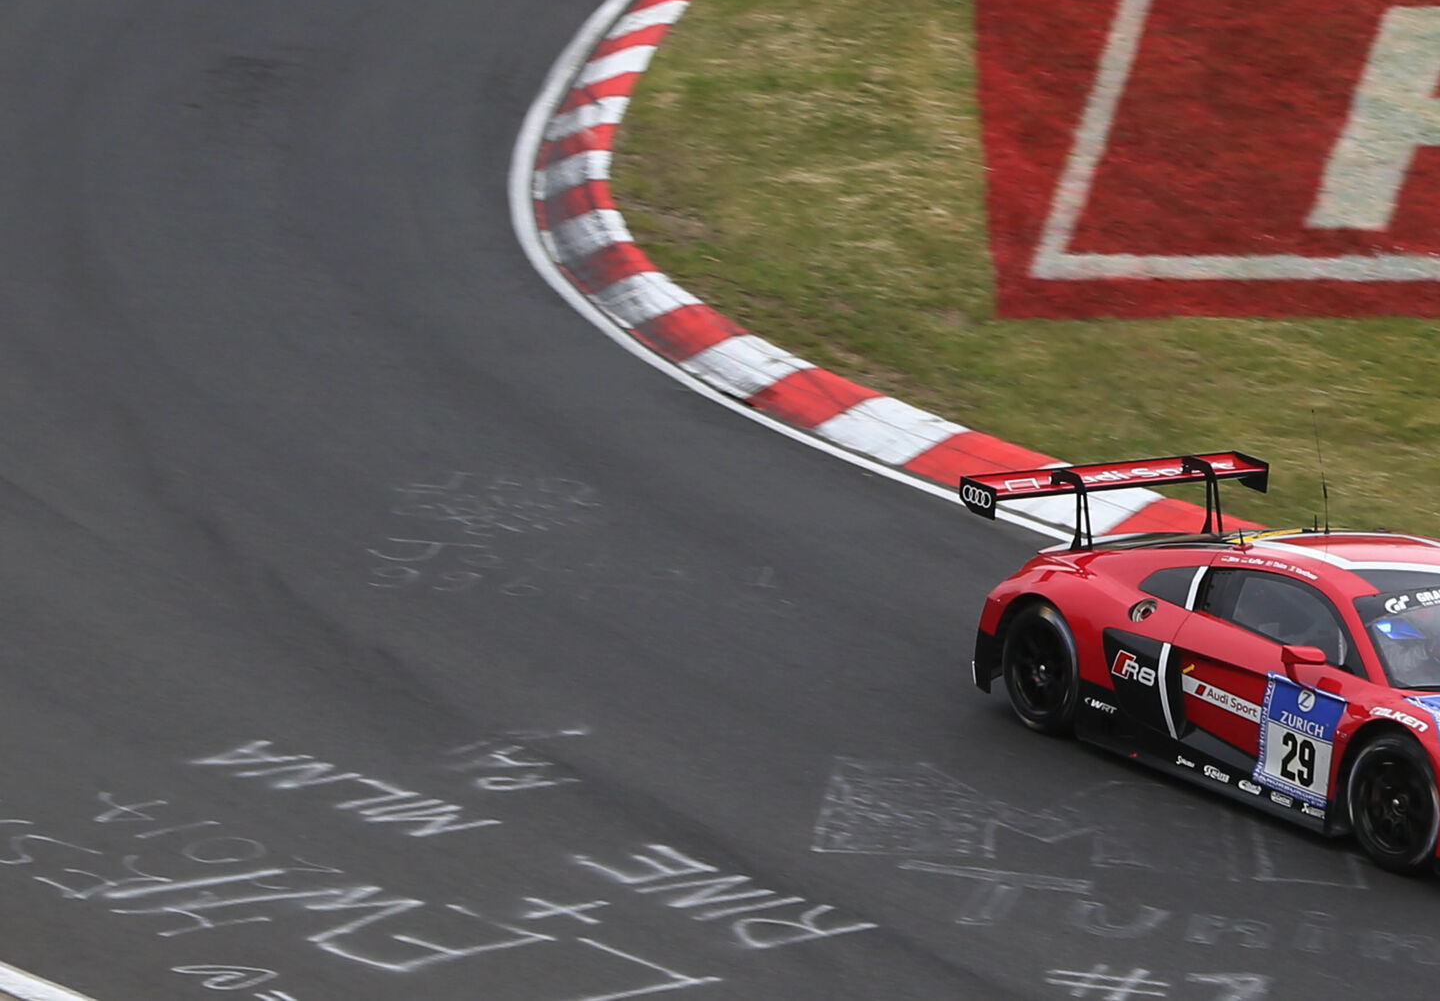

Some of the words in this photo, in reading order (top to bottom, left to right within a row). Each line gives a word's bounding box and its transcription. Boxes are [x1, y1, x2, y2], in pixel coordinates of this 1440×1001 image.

[1122, 659, 1155, 687] R8
[1090, 698, 1118, 715] WRT
[1206, 688, 1229, 706] Audi
[1230, 696, 1258, 718] Sport
[1280, 710, 1325, 739] ZURICH
[1280, 732, 1317, 788] 29
